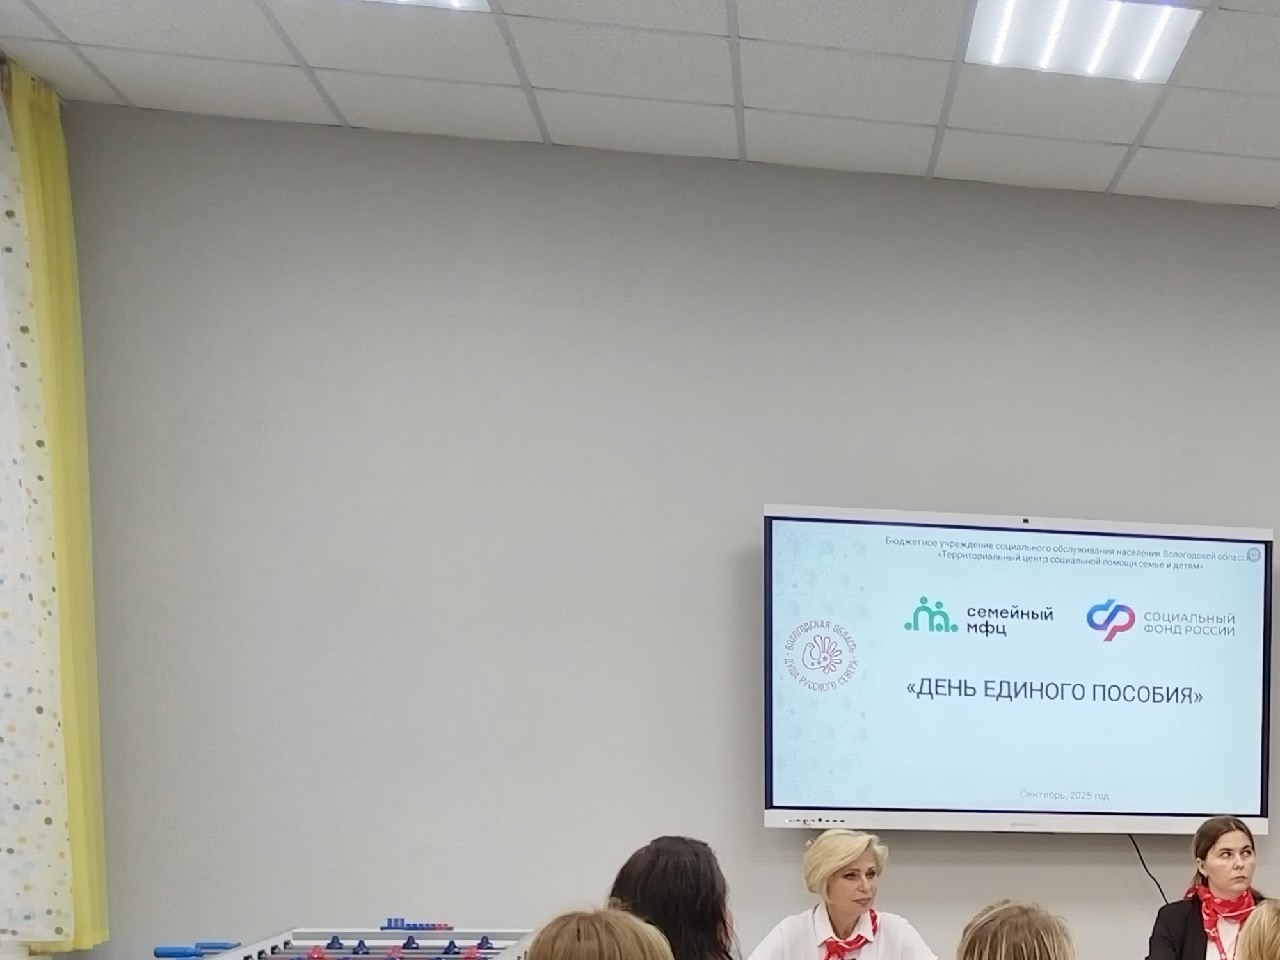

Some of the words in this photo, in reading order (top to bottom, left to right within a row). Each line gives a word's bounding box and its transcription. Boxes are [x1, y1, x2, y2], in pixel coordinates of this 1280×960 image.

[885, 536, 938, 547] Бюджетное
[939, 540, 994, 551] учреждение
[995, 544, 1052, 553] социального
[1053, 545, 1114, 556] обслуживания
[1116, 549, 1160, 558] населения
[1163, 550, 1215, 560] Вологодской
[1022, 556, 1049, 564] центр
[1050, 556, 1101, 566] социальной
[1102, 558, 1138, 568] помощи
[1140, 561, 1165, 569] семье
[967, 606, 1054, 622] семейный
[1144, 611, 1235, 625] СОЦИАЛЬНЫЙ
[967, 621, 1007, 638] мфц
[1144, 623, 1182, 636] ФОНД
[1185, 623, 1235, 637] РОССИИ
[906, 677, 977, 700] «ДЕНЬ
[983, 680, 1086, 702] ЕДИНОГО
[1092, 684, 1204, 704] ПОСОБИЯ»
[1020, 790, 1068, 801] Сентябрь,
[1070, 791, 1093, 801] 2025
[1094, 793, 1110, 802] год
